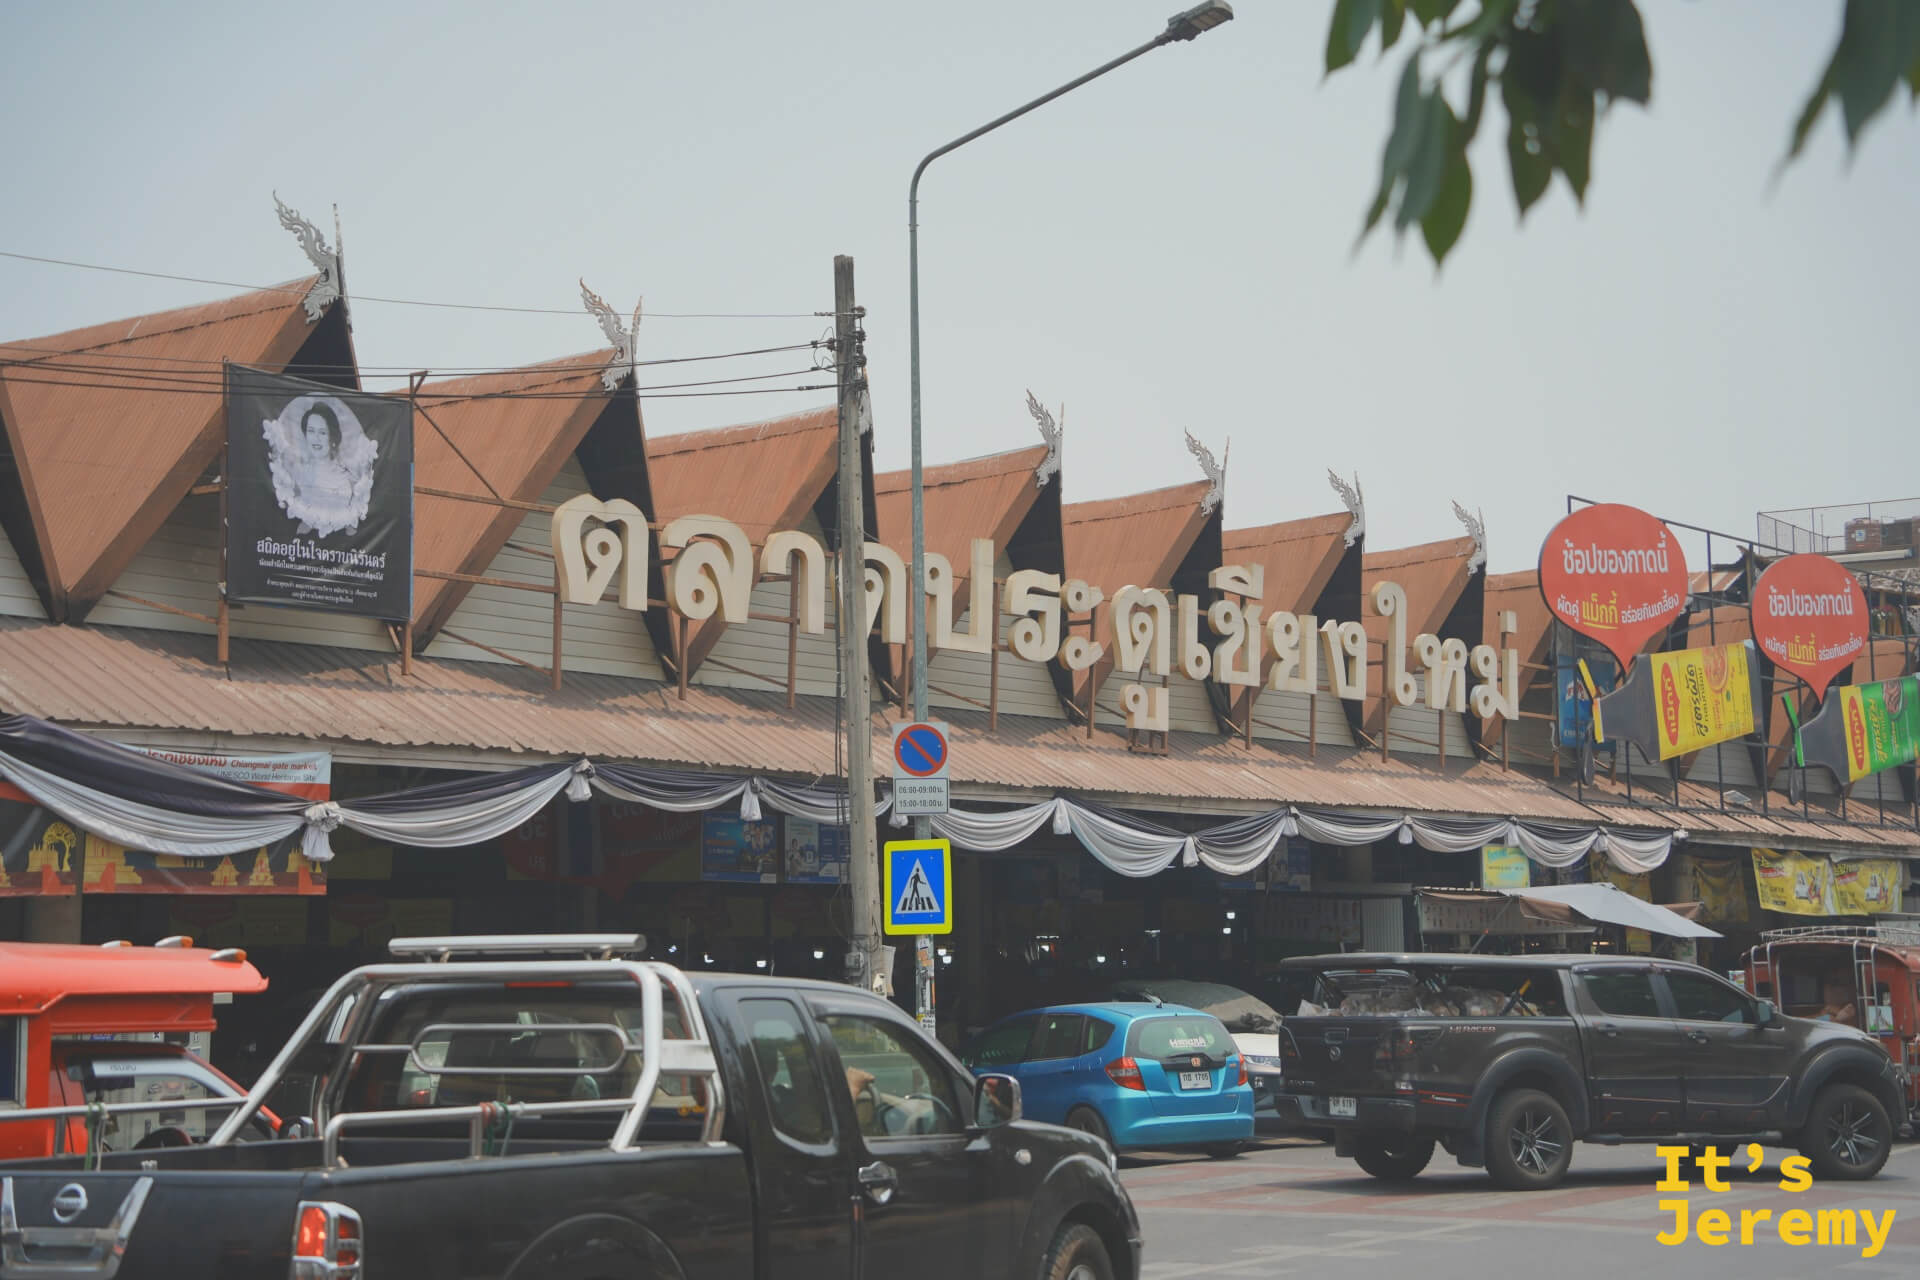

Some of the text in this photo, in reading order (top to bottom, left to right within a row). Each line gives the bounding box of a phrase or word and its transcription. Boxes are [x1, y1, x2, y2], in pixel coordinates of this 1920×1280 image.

[256, 536, 387, 569] สถิตอยู่ในใจตราบนิรันดร์
[1562, 531, 1669, 575] ช้อปของกาดนี้
[551, 493, 1520, 732] ตลาดประตูเชียงใหม่
[1768, 577, 1853, 617] ช้อปของกาดนี้
[272, 760, 289, 771] gate
